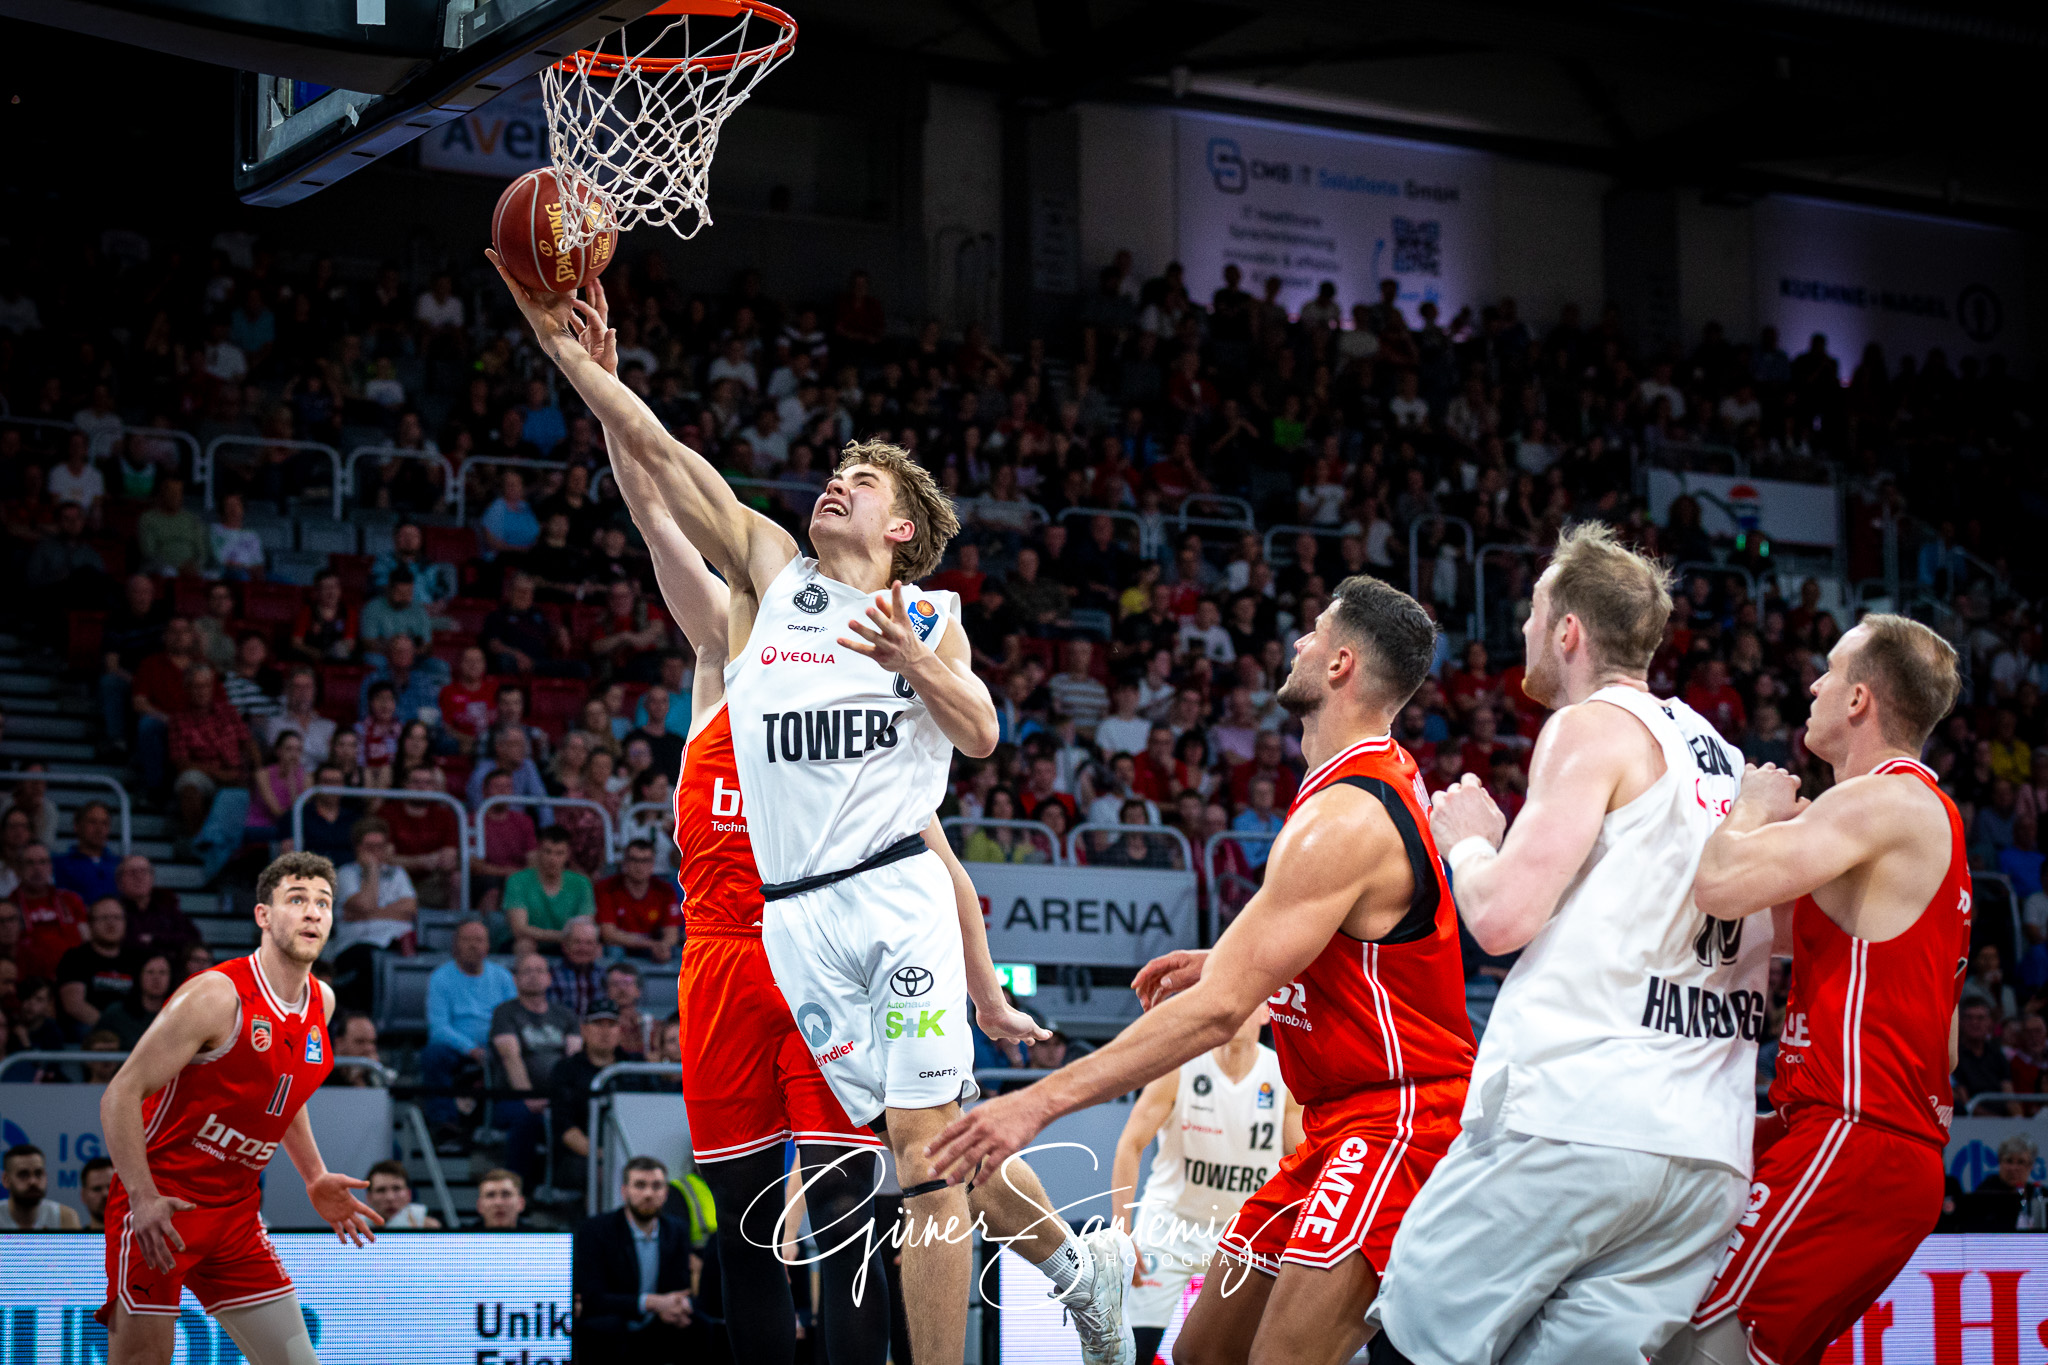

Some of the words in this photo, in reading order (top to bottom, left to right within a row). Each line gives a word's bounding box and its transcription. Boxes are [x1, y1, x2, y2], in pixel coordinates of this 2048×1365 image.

[545, 202, 578, 283] SPADING
[787, 624, 820, 633] CRAFT
[780, 650, 835, 665] VEOLIA
[762, 708, 905, 764] TOWERS
[711, 820, 750, 834] Techni
[1004, 897, 1174, 936] ARENA
[886, 1000, 931, 1009] Autohaus
[886, 1009, 947, 1039] S+K
[919, 1069, 952, 1079] CRAFT
[190, 1138, 227, 1163] Technik
[196, 1113, 279, 1161] bros
[1249, 1122, 1274, 1151] 12
[1184, 1157, 1268, 1193] TOWERS
